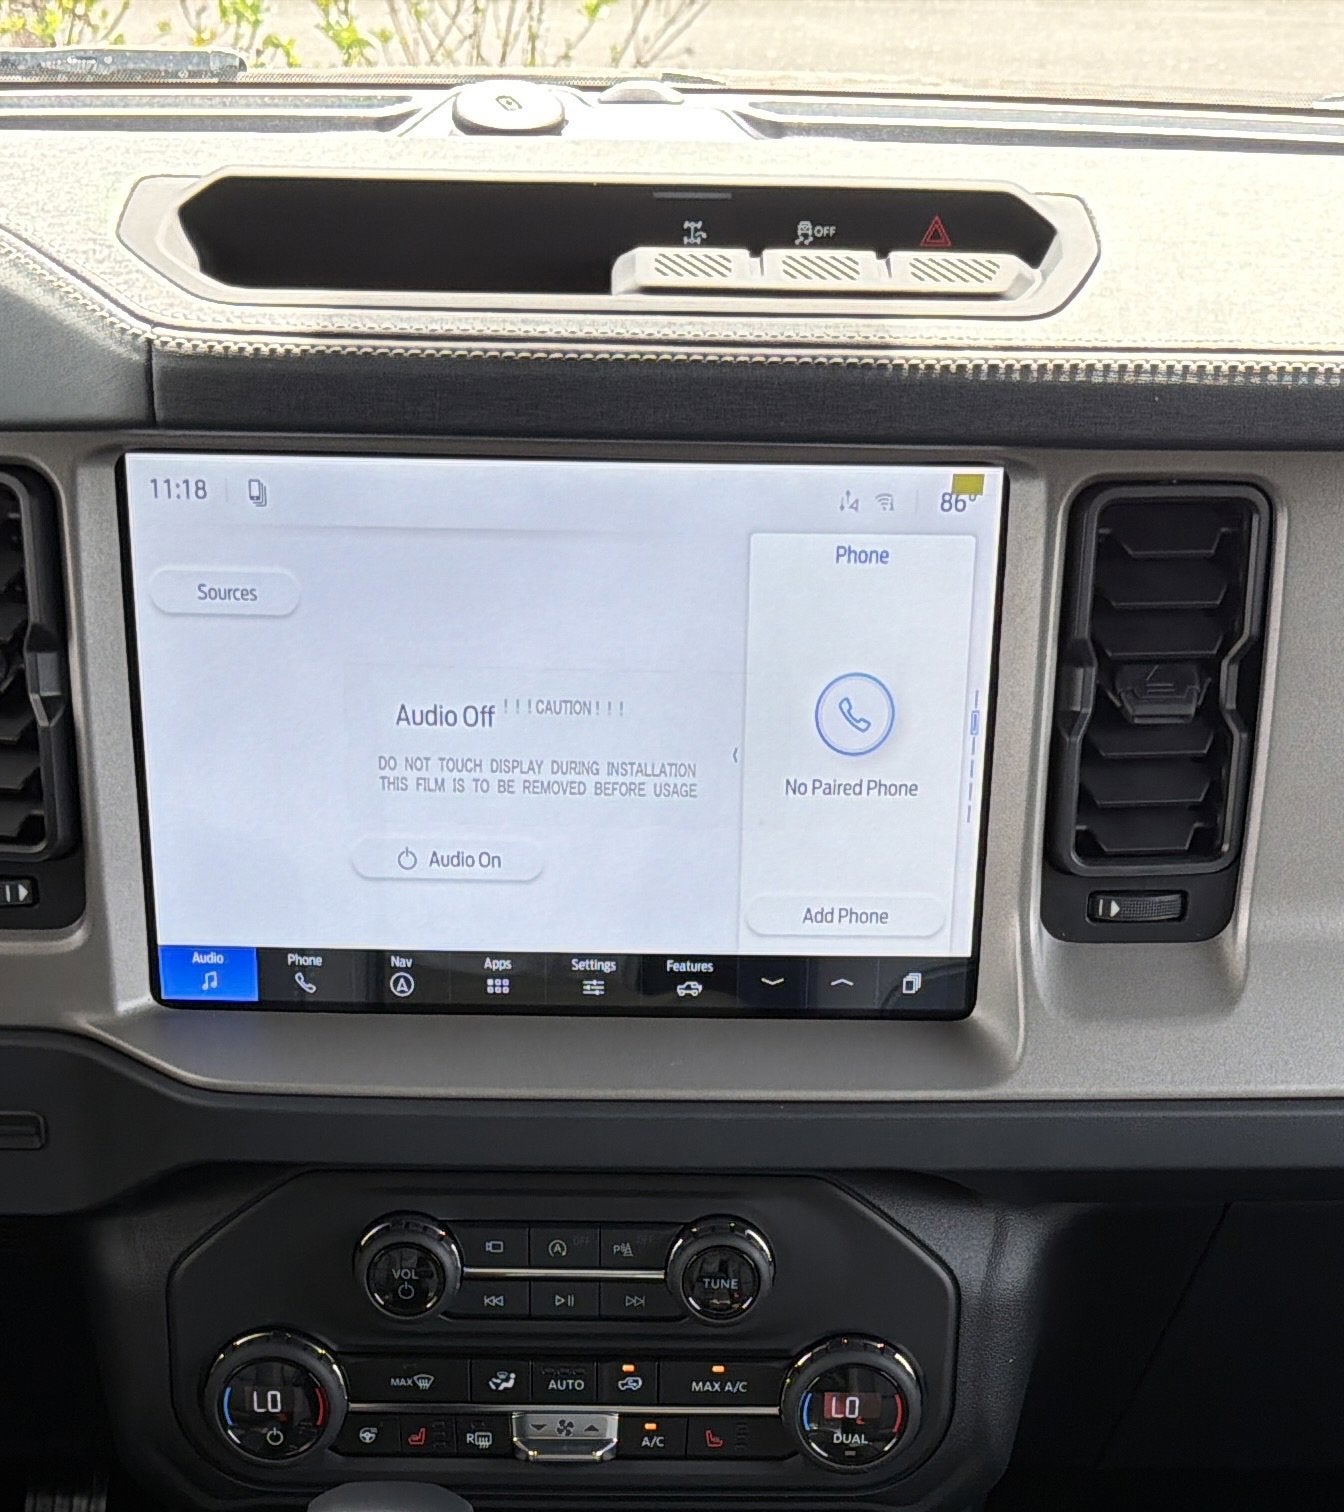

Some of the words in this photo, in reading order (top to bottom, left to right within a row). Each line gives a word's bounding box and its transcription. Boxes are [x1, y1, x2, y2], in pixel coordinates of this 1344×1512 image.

[814, 225, 836, 238] OFF
[149, 477, 208, 501] 11:18
[835, 545, 890, 566] Phone
[196, 582, 258, 603] Sources
[396, 703, 457, 729] Audio
[462, 703, 496, 729] Off
[378, 756, 397, 771] DO
[404, 757, 431, 773] NOT
[438, 758, 483, 774] TOUCH
[490, 759, 544, 775] DISPLAY
[551, 760, 599, 777] DURING
[606, 761, 697, 779] INSTALLATION
[379, 776, 409, 791] THIS
[416, 777, 445, 792] FILM
[453, 778, 465, 793] IS
[472, 778, 490, 793] TO
[498, 779, 516, 794] BE
[522, 779, 587, 796] REMOVED
[594, 781, 646, 797] BEFORE
[653, 782, 698, 798] USAGE
[785, 779, 807, 797] No
[811, 779, 863, 798] Paired
[866, 779, 919, 798] Phone
[429, 851, 475, 869] Audio
[478, 851, 502, 869] On
[802, 907, 834, 925] Add
[838, 907, 889, 926] Phone
[192, 951, 224, 965] Audio
[287, 953, 323, 967] Phone
[391, 955, 413, 969] Nav
[484, 957, 512, 972] Apps
[571, 958, 617, 973] Settings
[666, 959, 714, 973] Features
[391, 1268, 419, 1281] VOL
[702, 1278, 739, 1290] TUNE
[390, 1377, 413, 1387] MAX
[548, 1379, 585, 1392] AUTO
[692, 1381, 721, 1393] MAX
[722, 1380, 748, 1394] A/C
[641, 1435, 665, 1448] A/C
[833, 1433, 869, 1445] DUAL
